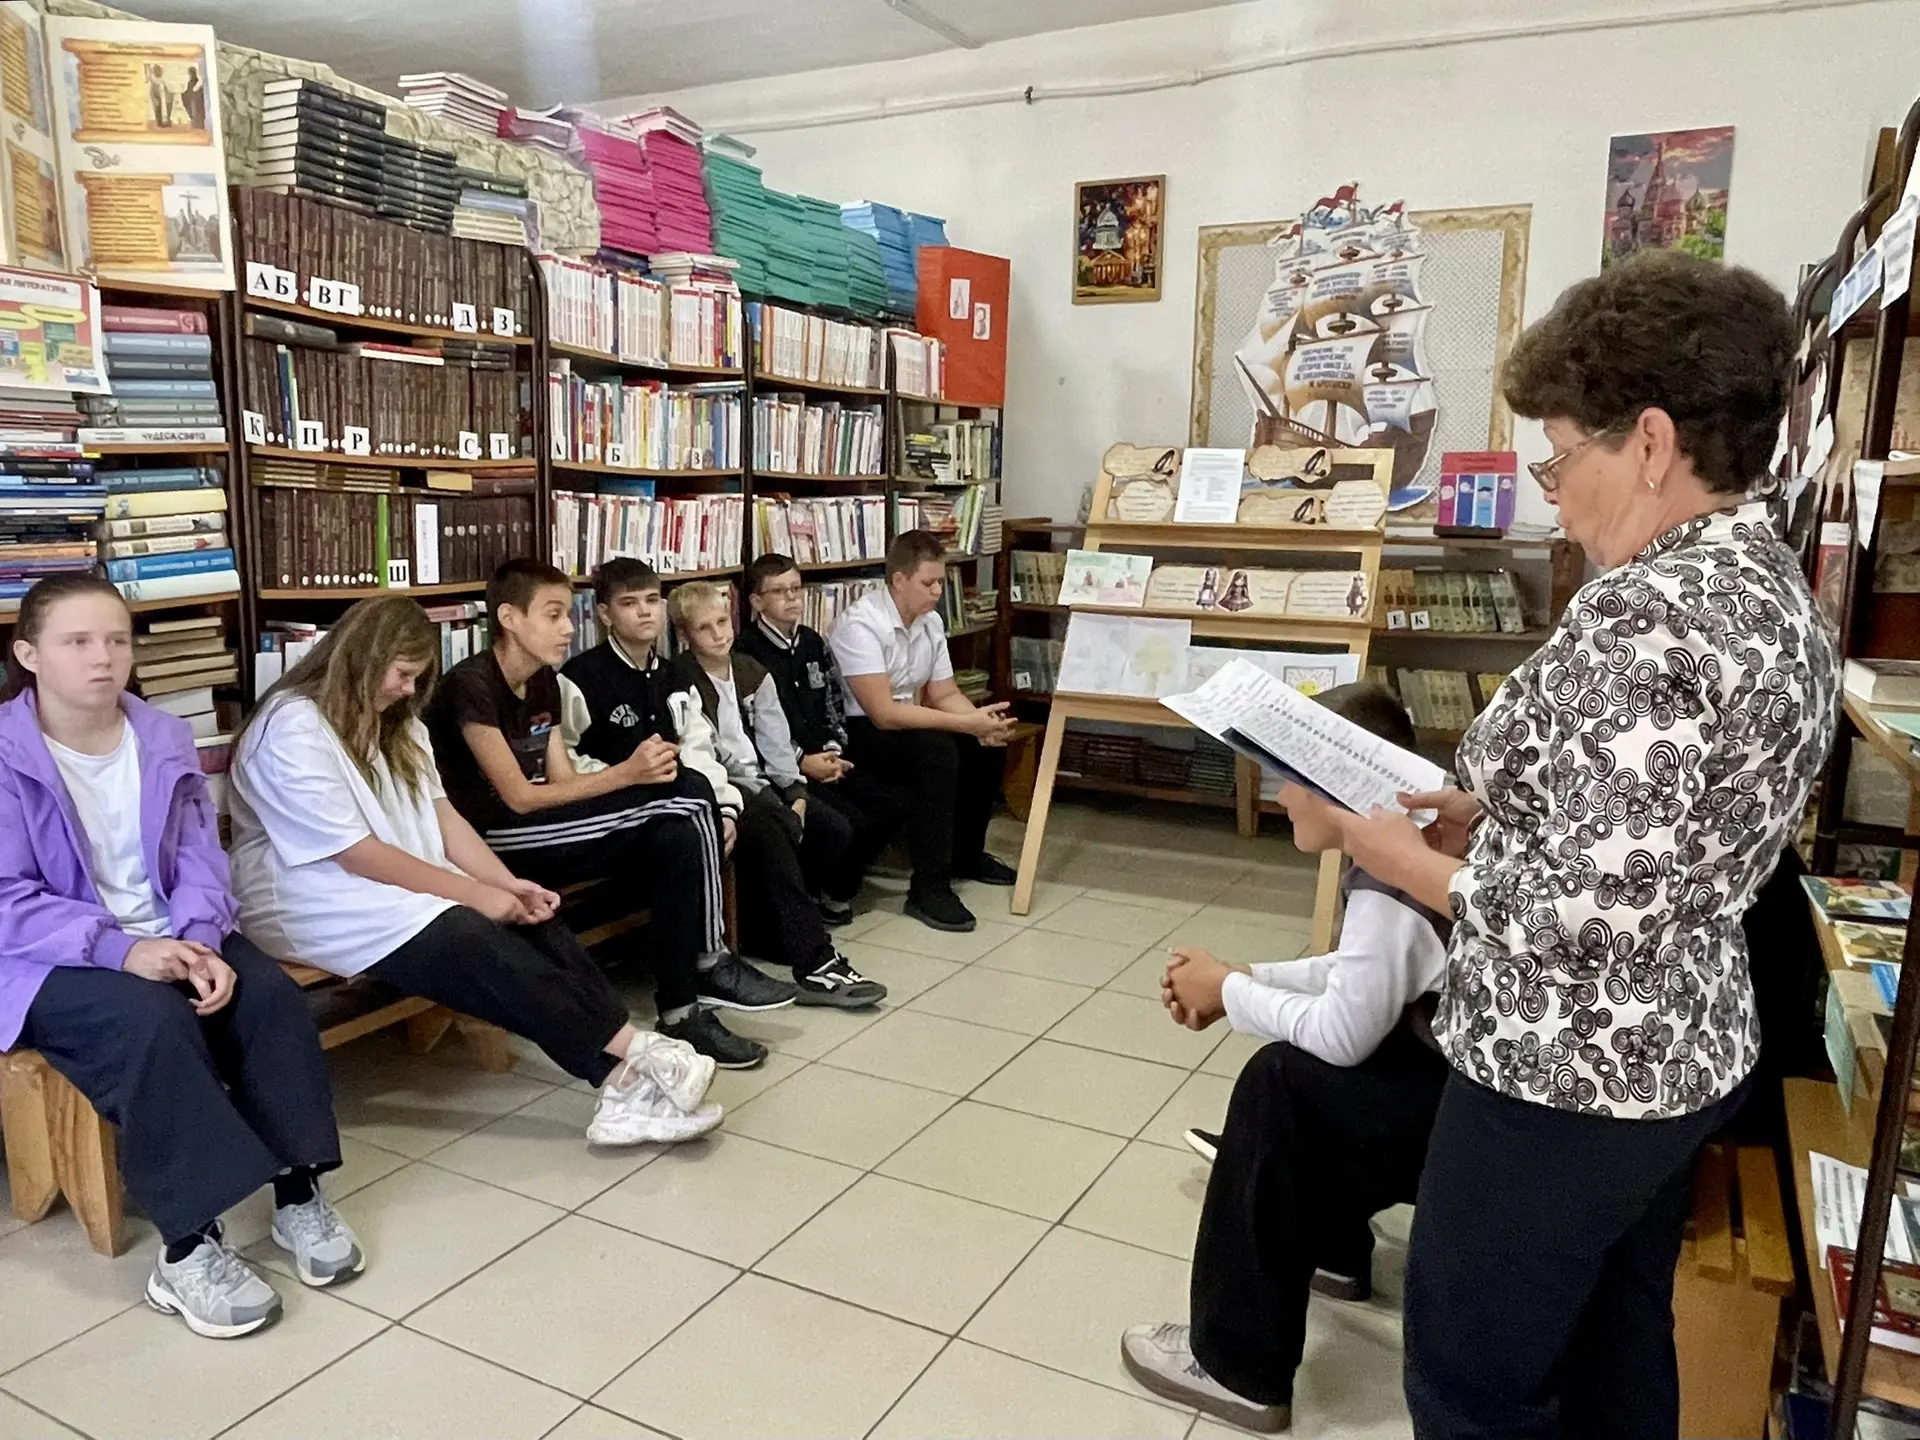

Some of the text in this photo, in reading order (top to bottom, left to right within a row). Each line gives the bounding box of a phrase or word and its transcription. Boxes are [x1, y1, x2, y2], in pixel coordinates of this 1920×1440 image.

[254, 271, 270, 291] А
[275, 277, 289, 295] Б
[318, 285, 331, 304] В
[338, 289, 352, 306] Г
[459, 309, 473, 328] Д
[250, 417, 261, 436] К
[303, 426, 319, 444] П
[352, 432, 363, 450] Р
[464, 437, 474, 454] С
[495, 439, 505, 455] Т
[612, 447, 621, 462] Б
[664, 556, 673, 569] К
[389, 565, 407, 582] Ш
[1414, 614, 1425, 625] К
